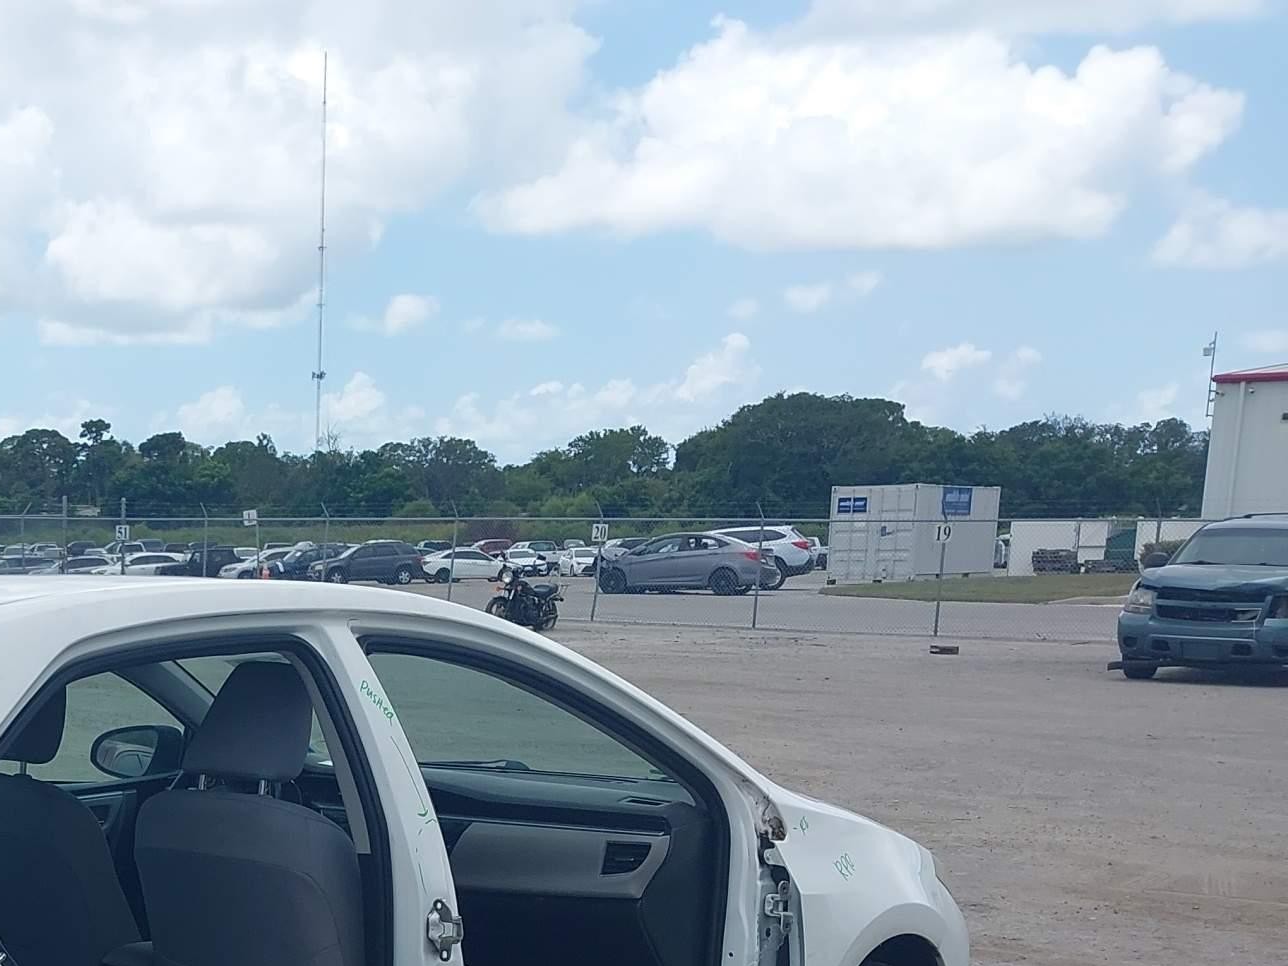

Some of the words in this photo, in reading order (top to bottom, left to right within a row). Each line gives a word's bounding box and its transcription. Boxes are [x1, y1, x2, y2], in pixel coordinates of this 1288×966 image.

[117, 526, 127, 539] 51
[593, 525, 607, 540] 20
[936, 526, 952, 541] 19
